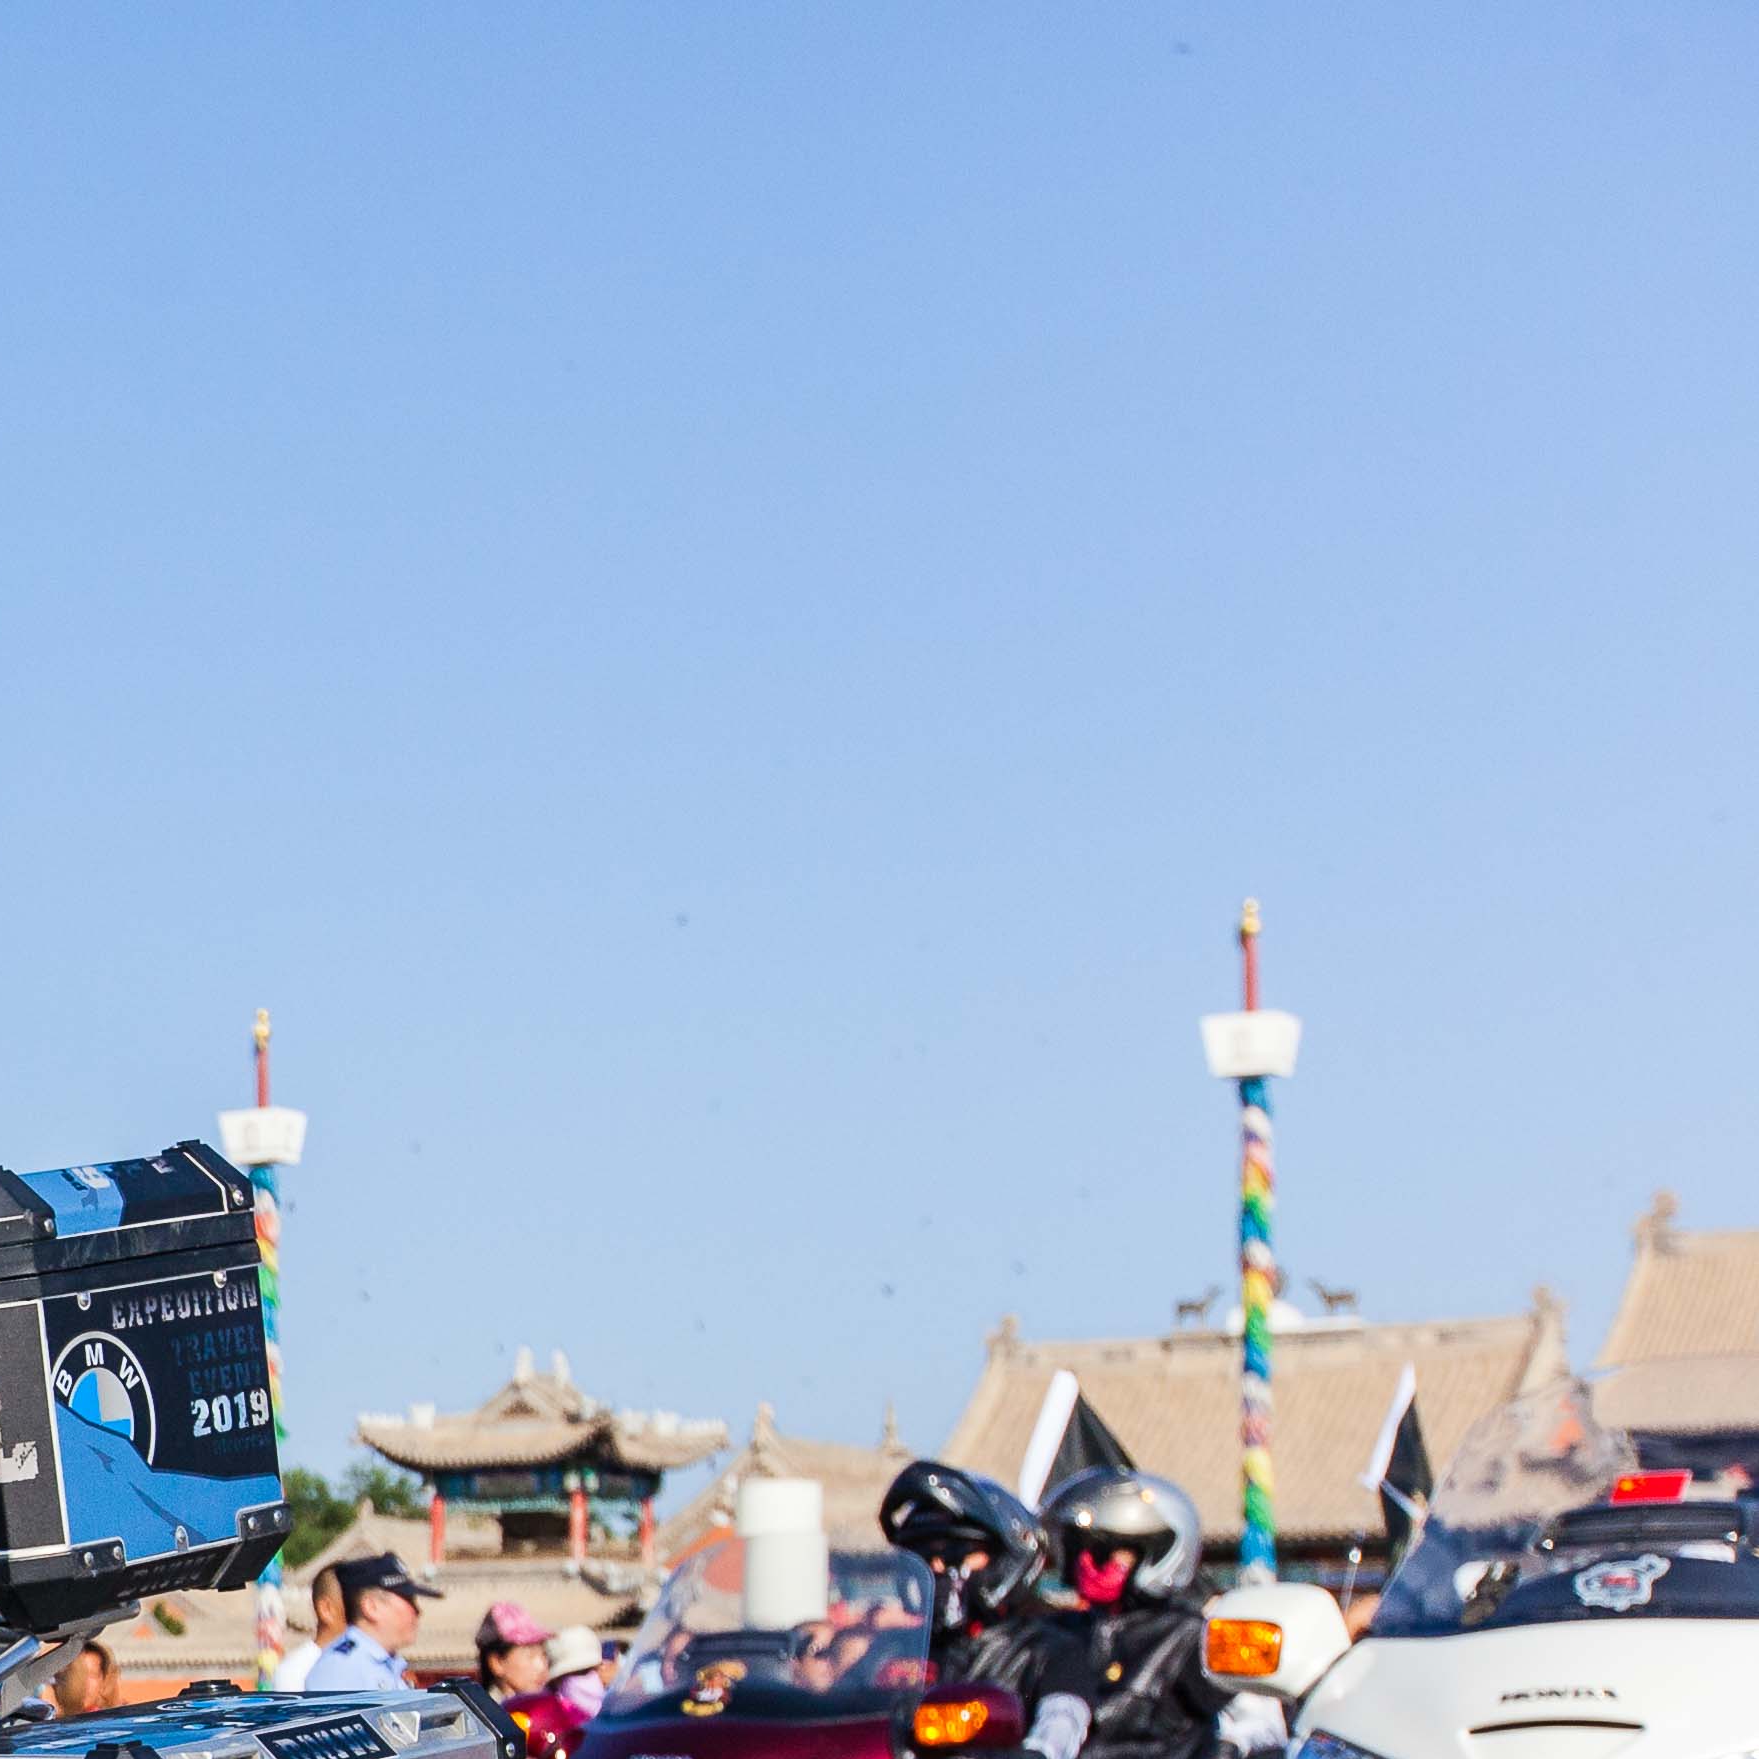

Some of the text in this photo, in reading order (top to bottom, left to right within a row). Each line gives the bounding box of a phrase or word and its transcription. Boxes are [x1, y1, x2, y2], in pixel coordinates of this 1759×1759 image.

[111, 1279, 259, 1330] EXPEDITION
[56, 1342, 140, 1396] BMW
[190, 1388, 270, 1438] 2019
